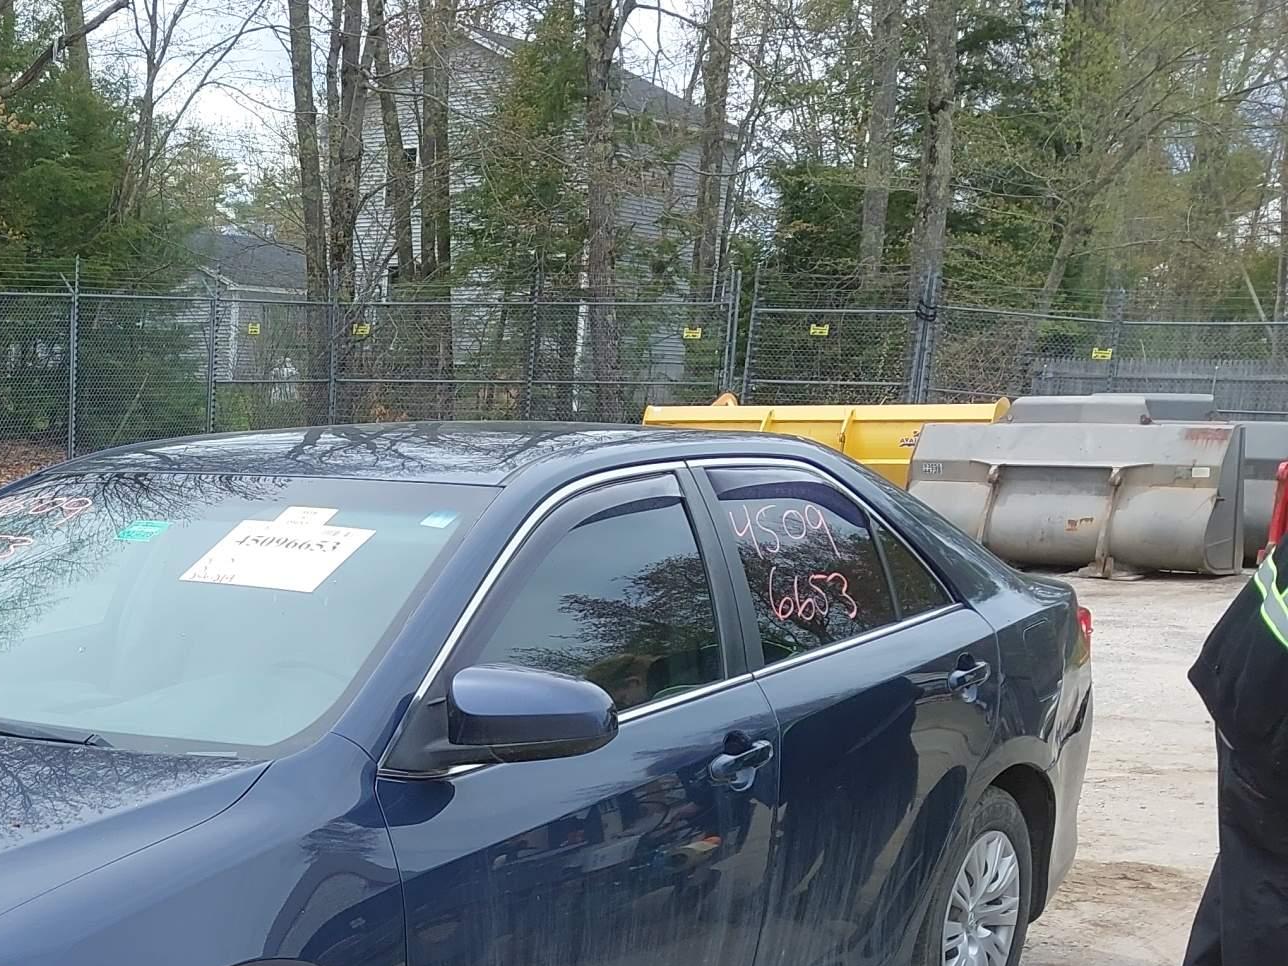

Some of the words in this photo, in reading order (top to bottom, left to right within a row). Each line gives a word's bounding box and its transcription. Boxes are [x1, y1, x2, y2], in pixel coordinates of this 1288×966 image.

[236, 535, 341, 552] 45096653
[729, 504, 842, 560] 4509
[769, 566, 857, 621] 6653
